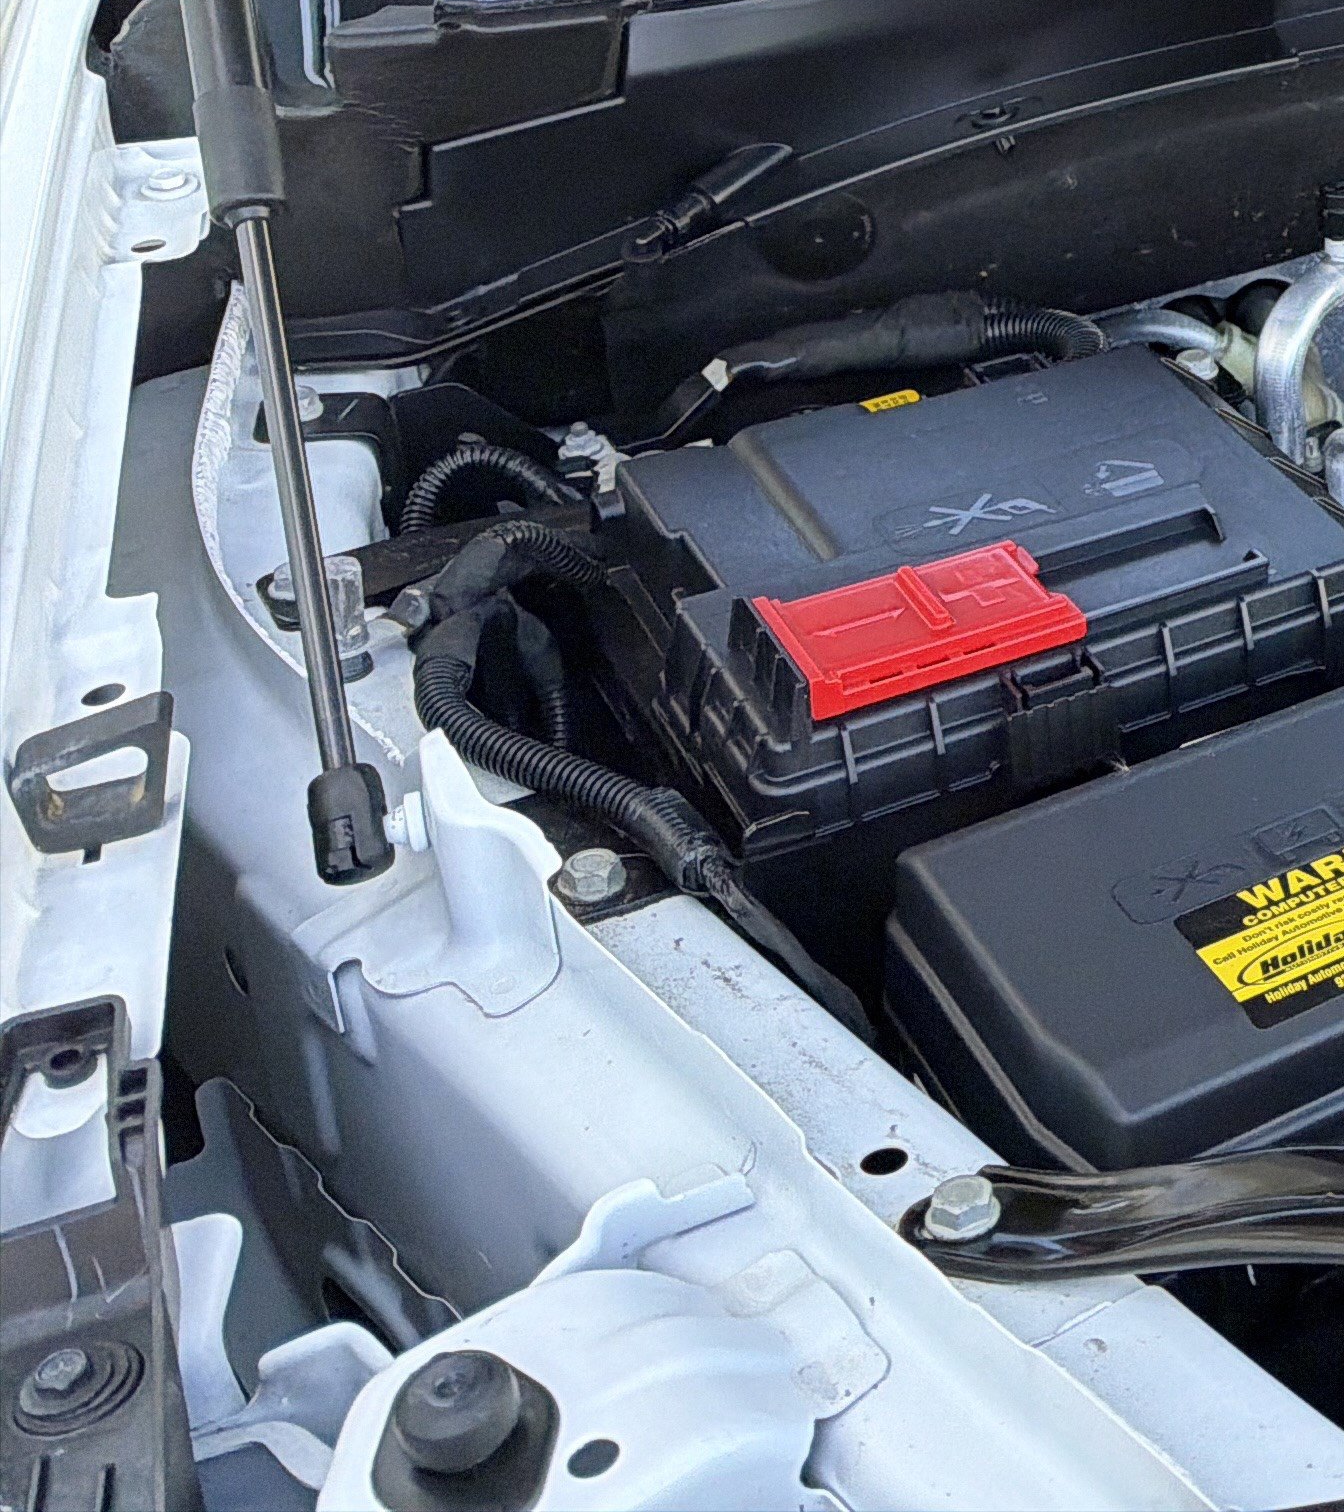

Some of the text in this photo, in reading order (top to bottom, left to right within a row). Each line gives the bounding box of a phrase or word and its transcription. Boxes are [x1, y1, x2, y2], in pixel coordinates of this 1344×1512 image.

[1212, 950, 1236, 965] Call
[1236, 934, 1280, 956] Holiday
[1281, 907, 1344, 937] Automotive
[1241, 925, 1274, 943] Don't
[1274, 915, 1296, 931] risk
[1297, 900, 1331, 920] costly
[1264, 978, 1308, 1004] Holiday
